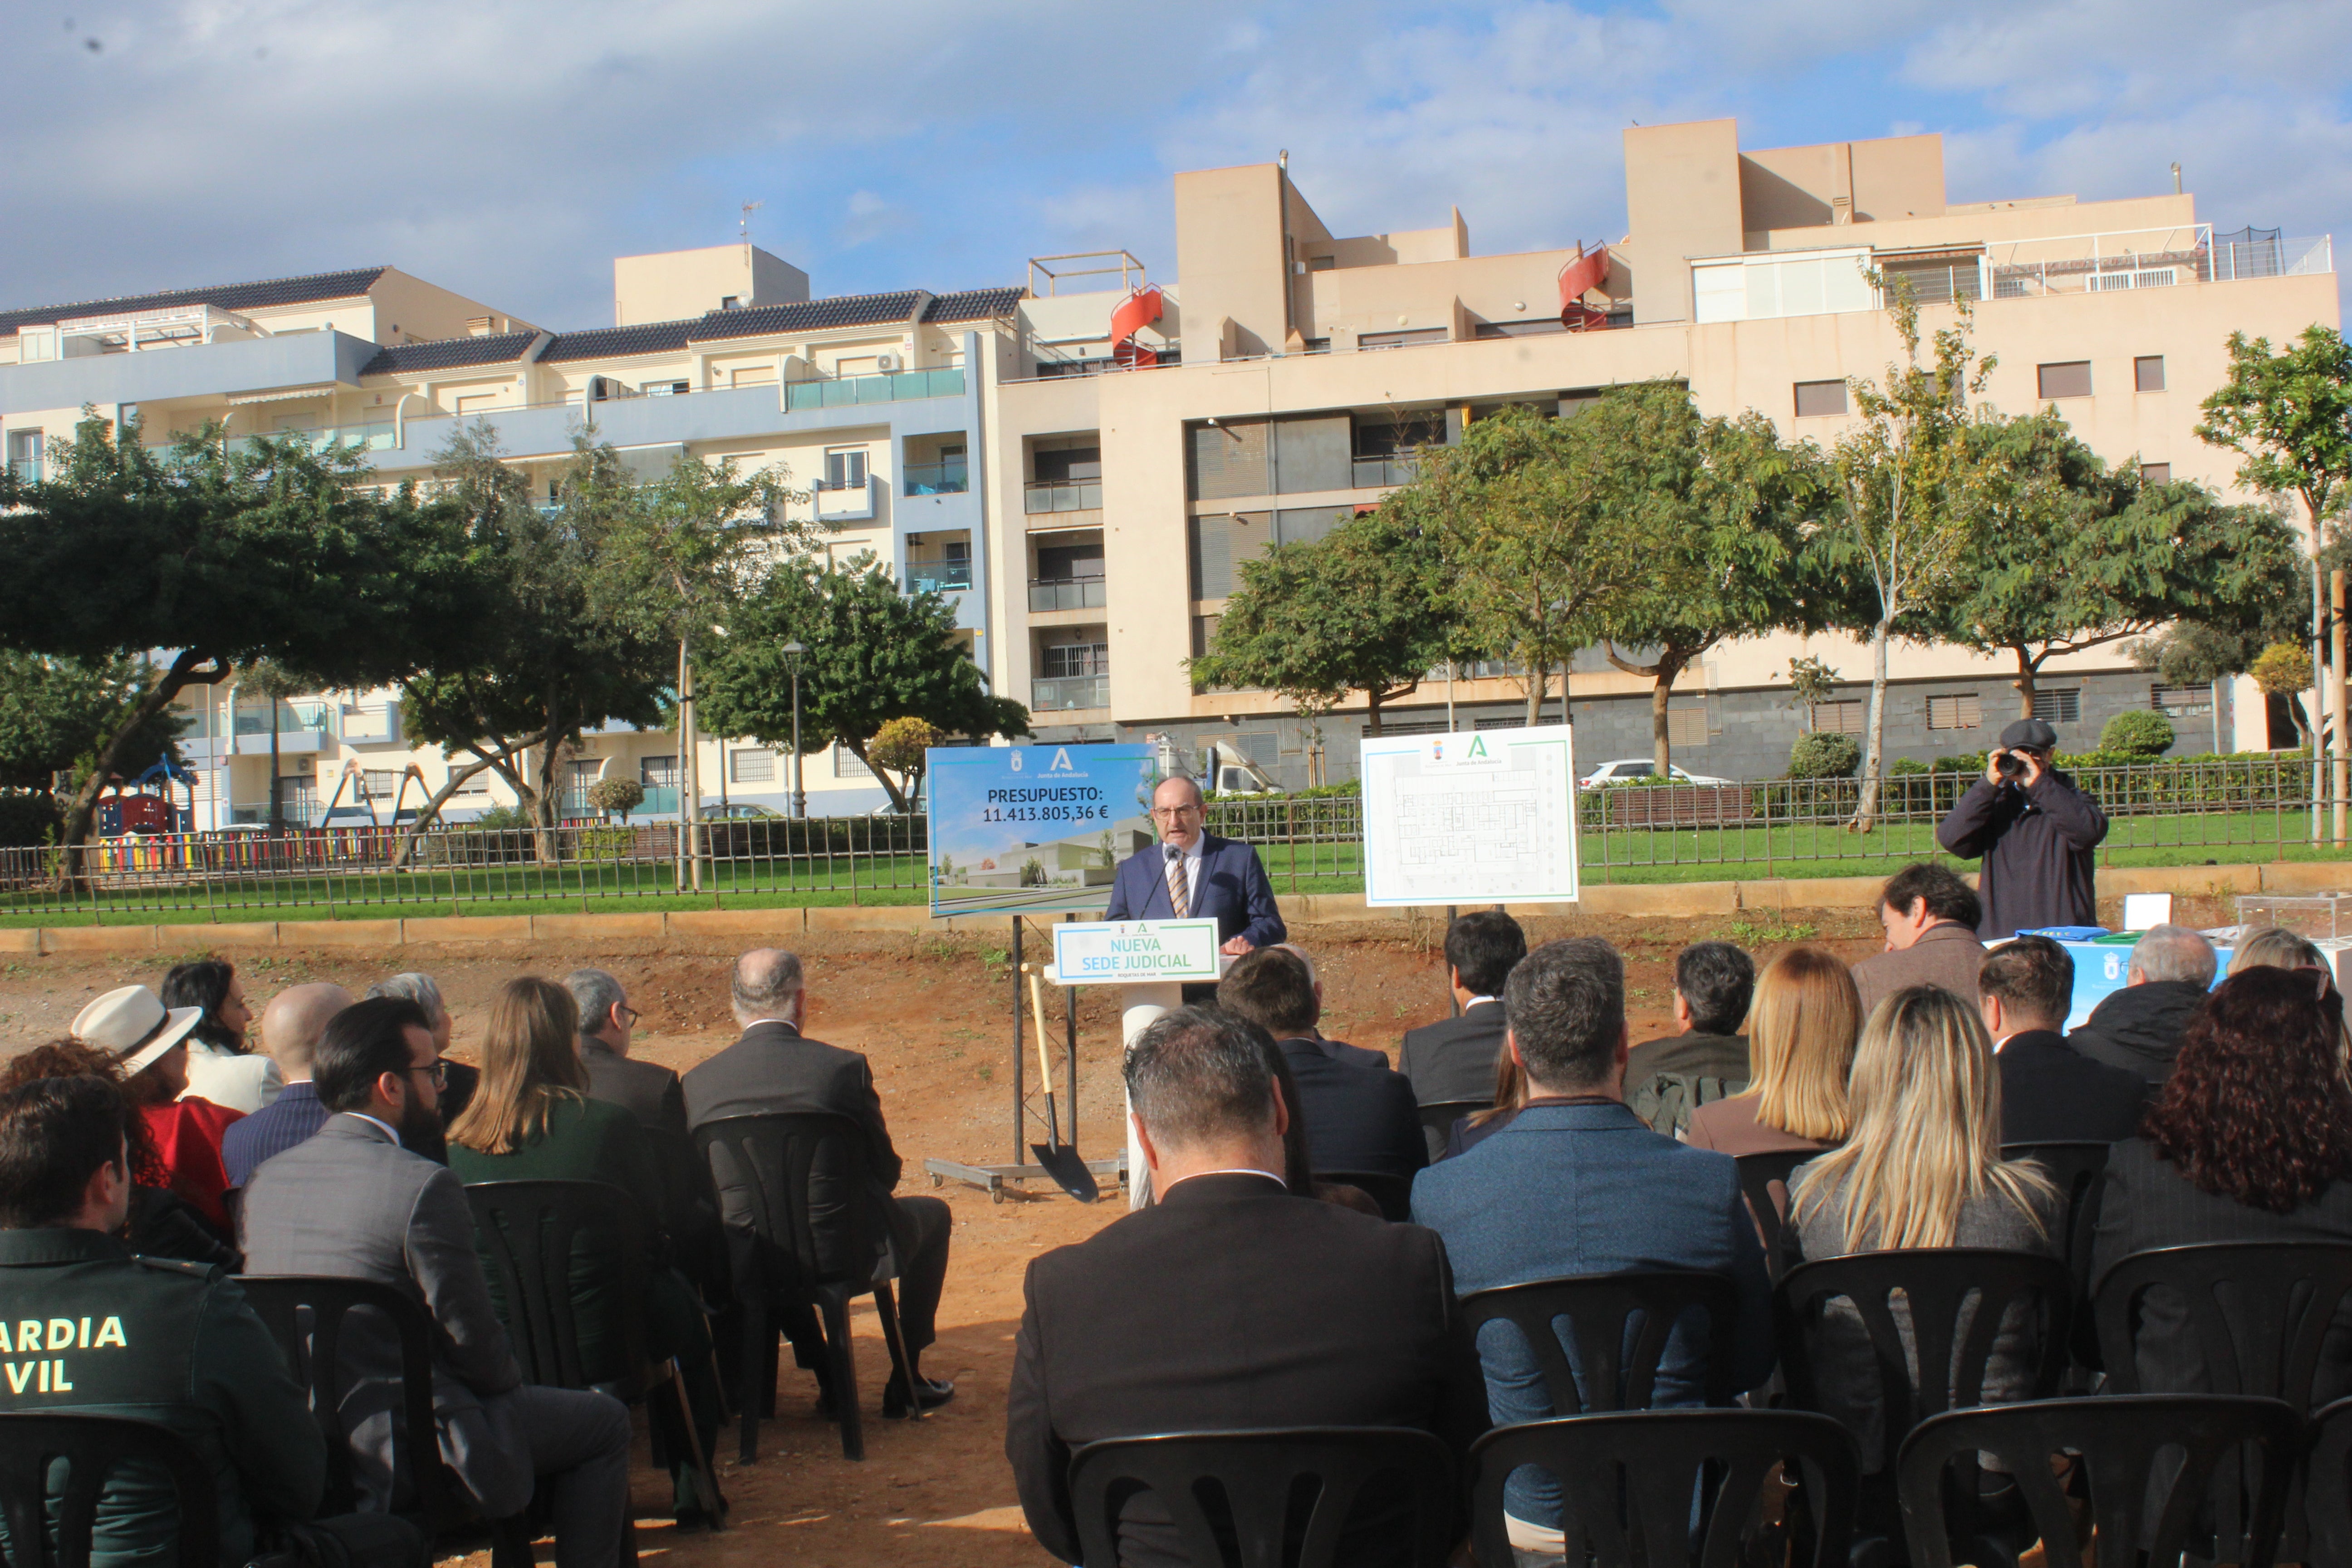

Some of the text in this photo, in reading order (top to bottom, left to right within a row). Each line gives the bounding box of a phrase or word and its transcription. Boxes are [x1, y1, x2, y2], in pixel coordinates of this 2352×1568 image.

[988, 787, 1103, 803] PRESUPUESTO:
[984, 805, 1108, 822] 11.413.805,36 €
[1111, 938, 1161, 952] NUEVA
[1083, 954, 1191, 970] SEDE JUDICIAL
